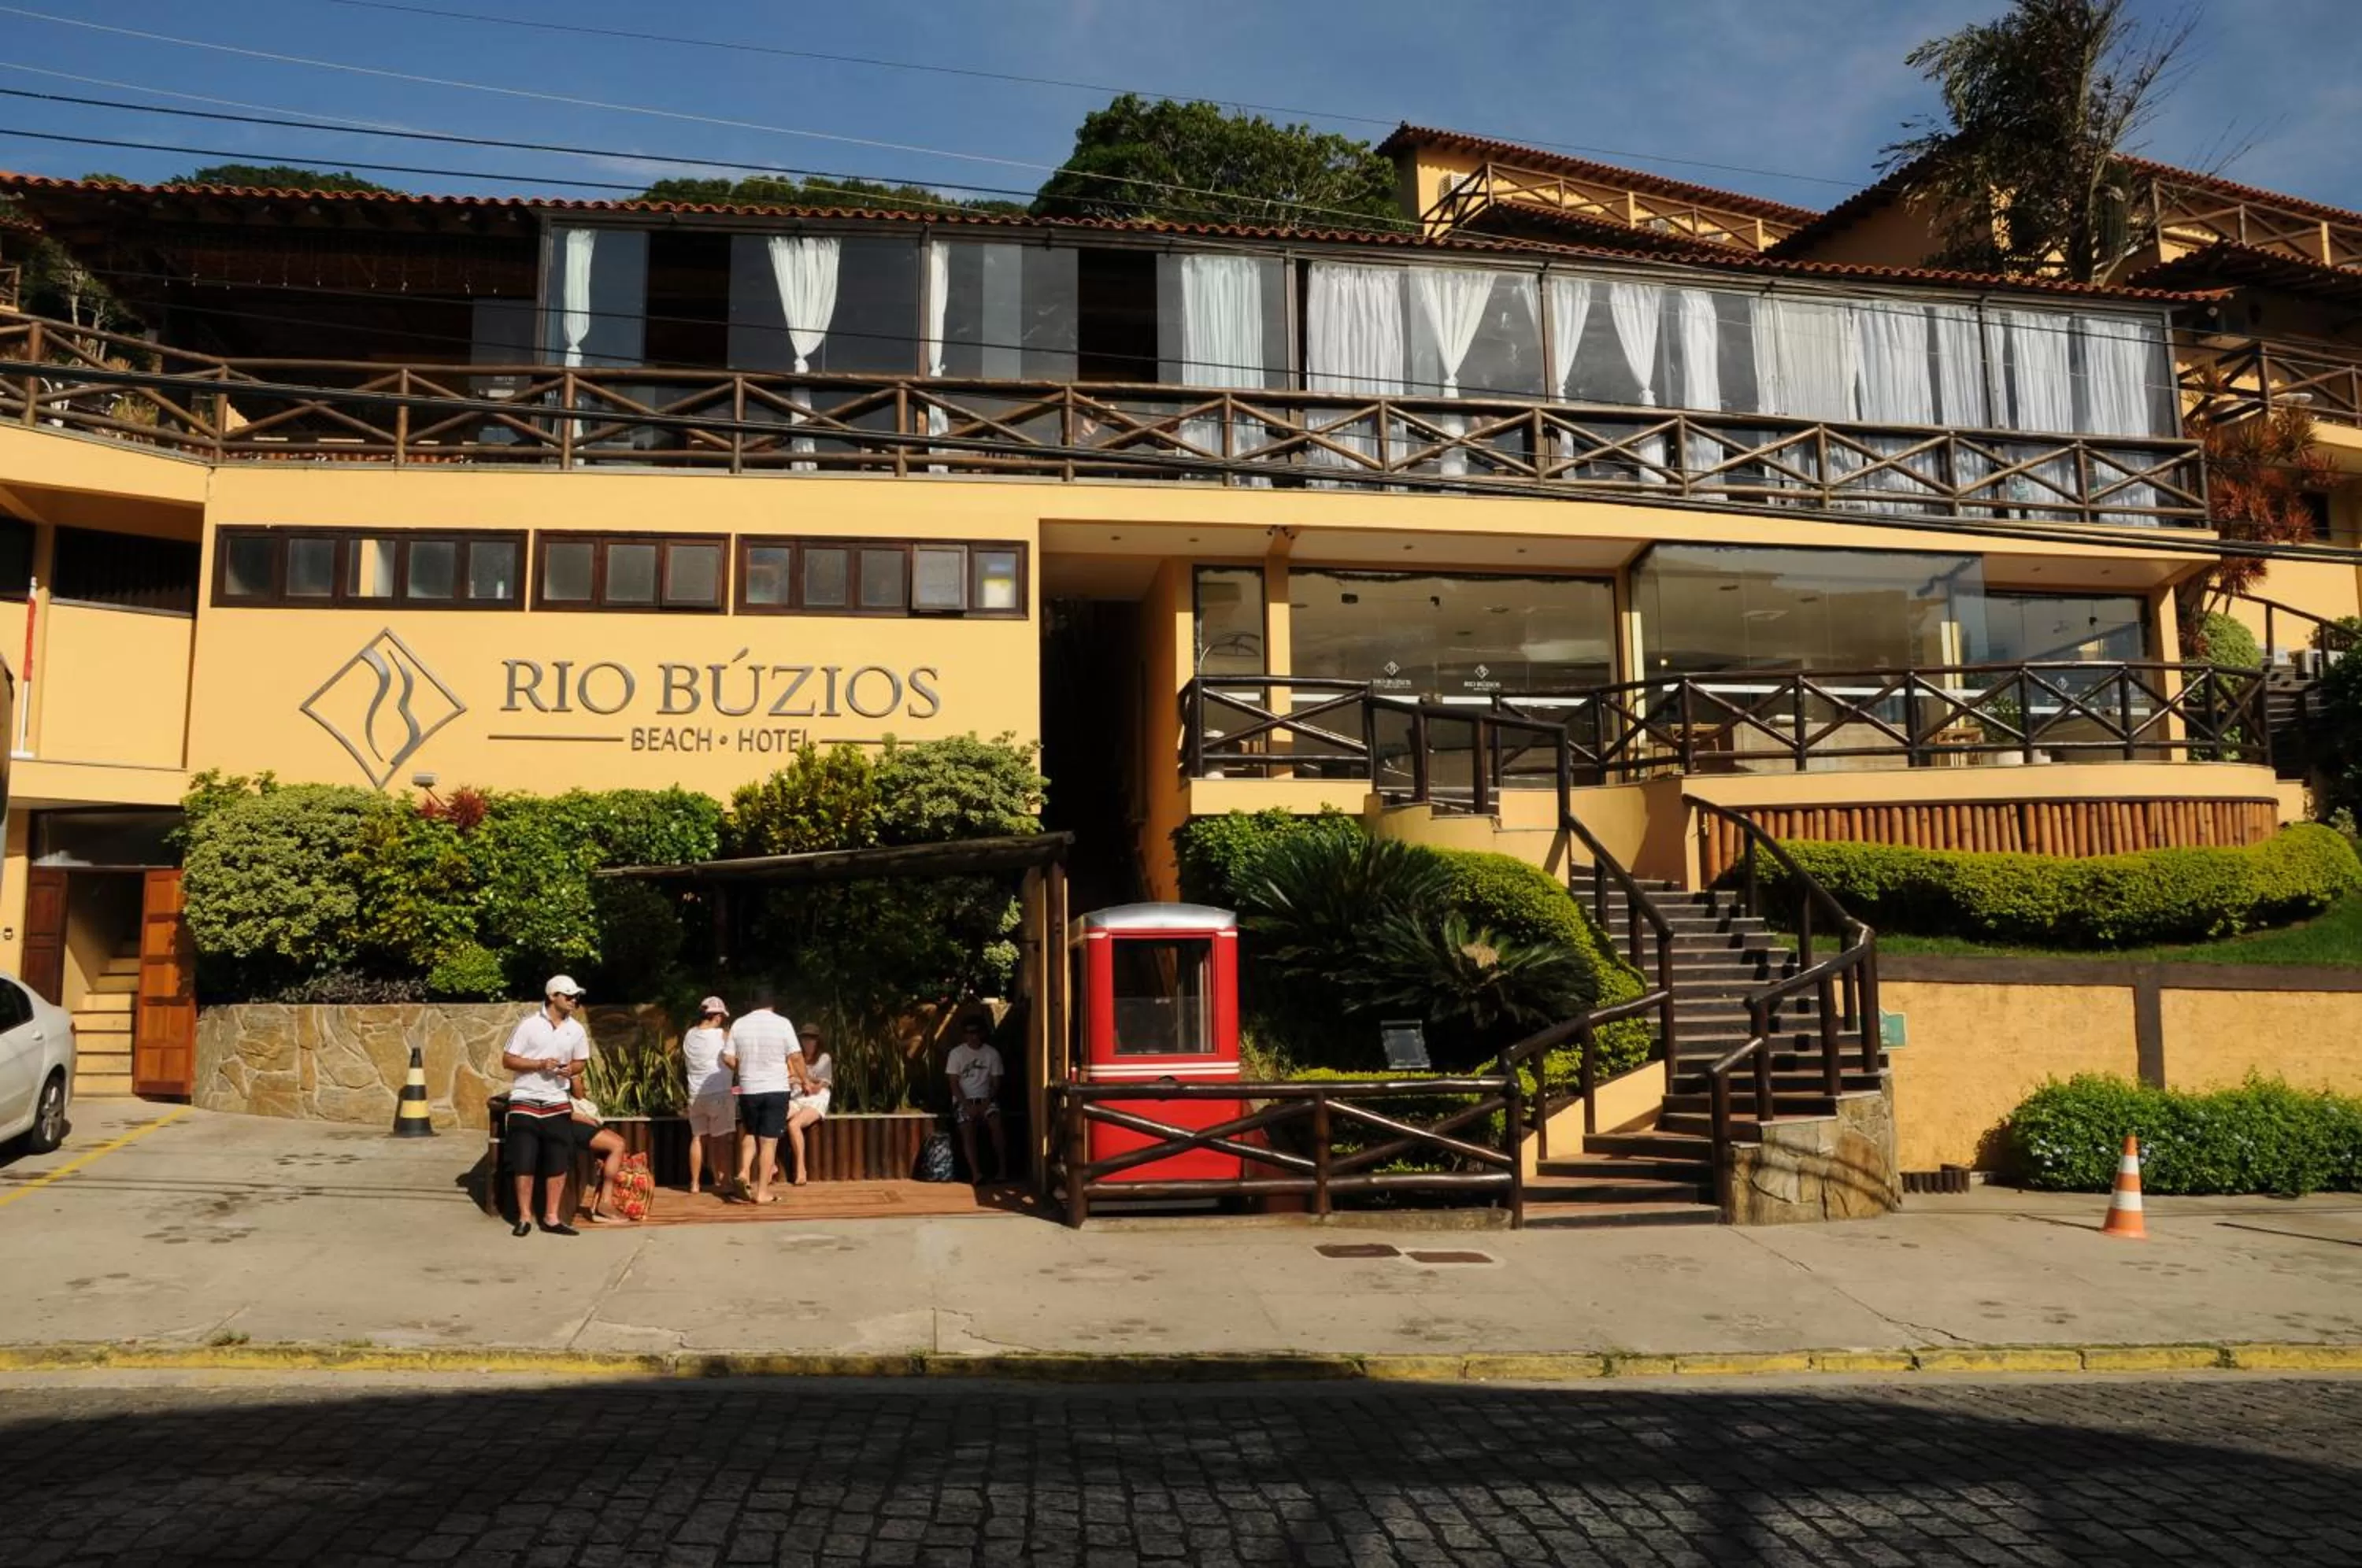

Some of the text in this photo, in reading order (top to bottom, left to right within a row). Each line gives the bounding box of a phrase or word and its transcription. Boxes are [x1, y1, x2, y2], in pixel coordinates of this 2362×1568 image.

[499, 646, 941, 719] RIO BÚZIOS
[630, 727, 713, 752] BEACH
